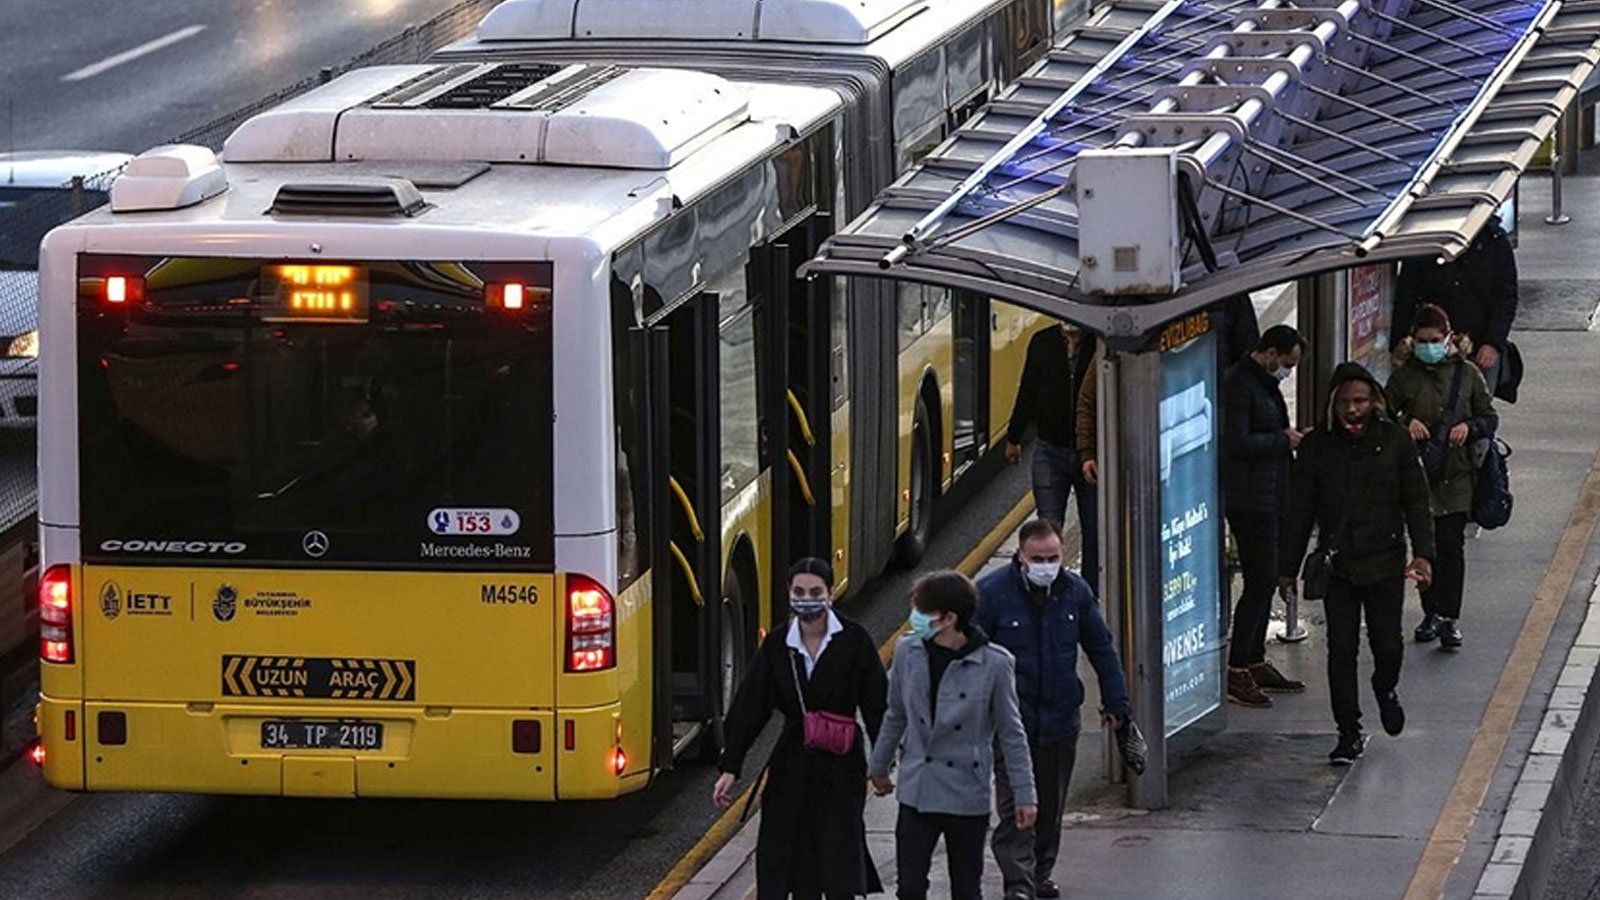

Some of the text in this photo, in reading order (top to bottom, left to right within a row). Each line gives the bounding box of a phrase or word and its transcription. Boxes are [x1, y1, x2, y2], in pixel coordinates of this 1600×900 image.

[457, 516, 491, 533] 153
[100, 540, 247, 553] CONECTO
[420, 542, 531, 558] Mercedes-Benz
[126, 589, 172, 610] İETT
[481, 584, 538, 605] M4546
[256, 669, 379, 690] UZUN ARAÇ
[266, 724, 377, 746] 34 TP 2119
